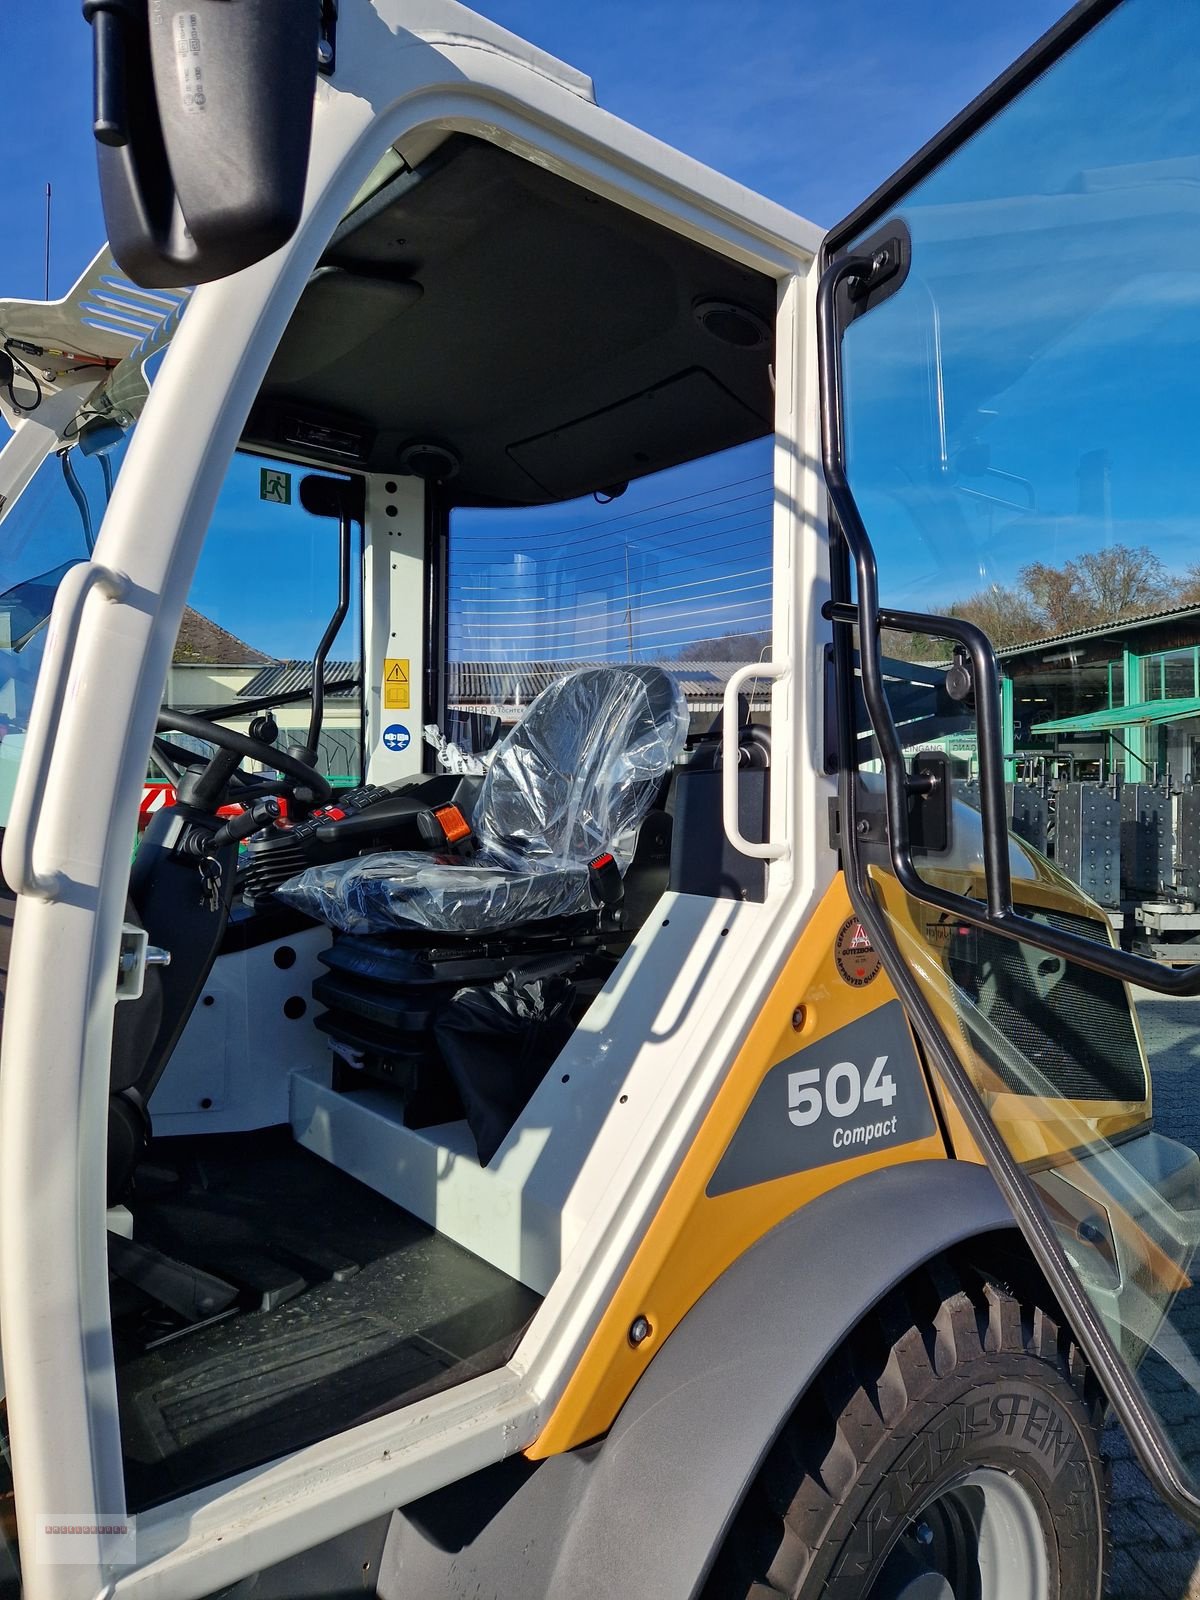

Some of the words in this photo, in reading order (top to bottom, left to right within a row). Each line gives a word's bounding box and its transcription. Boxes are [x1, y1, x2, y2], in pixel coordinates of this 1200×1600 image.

[490, 706, 497, 714] &
[837, 957, 864, 985] APPROVED
[863, 959, 882, 984] QUALIT
[788, 1055, 897, 1127] 504
[832, 1115, 898, 1148] Compact
